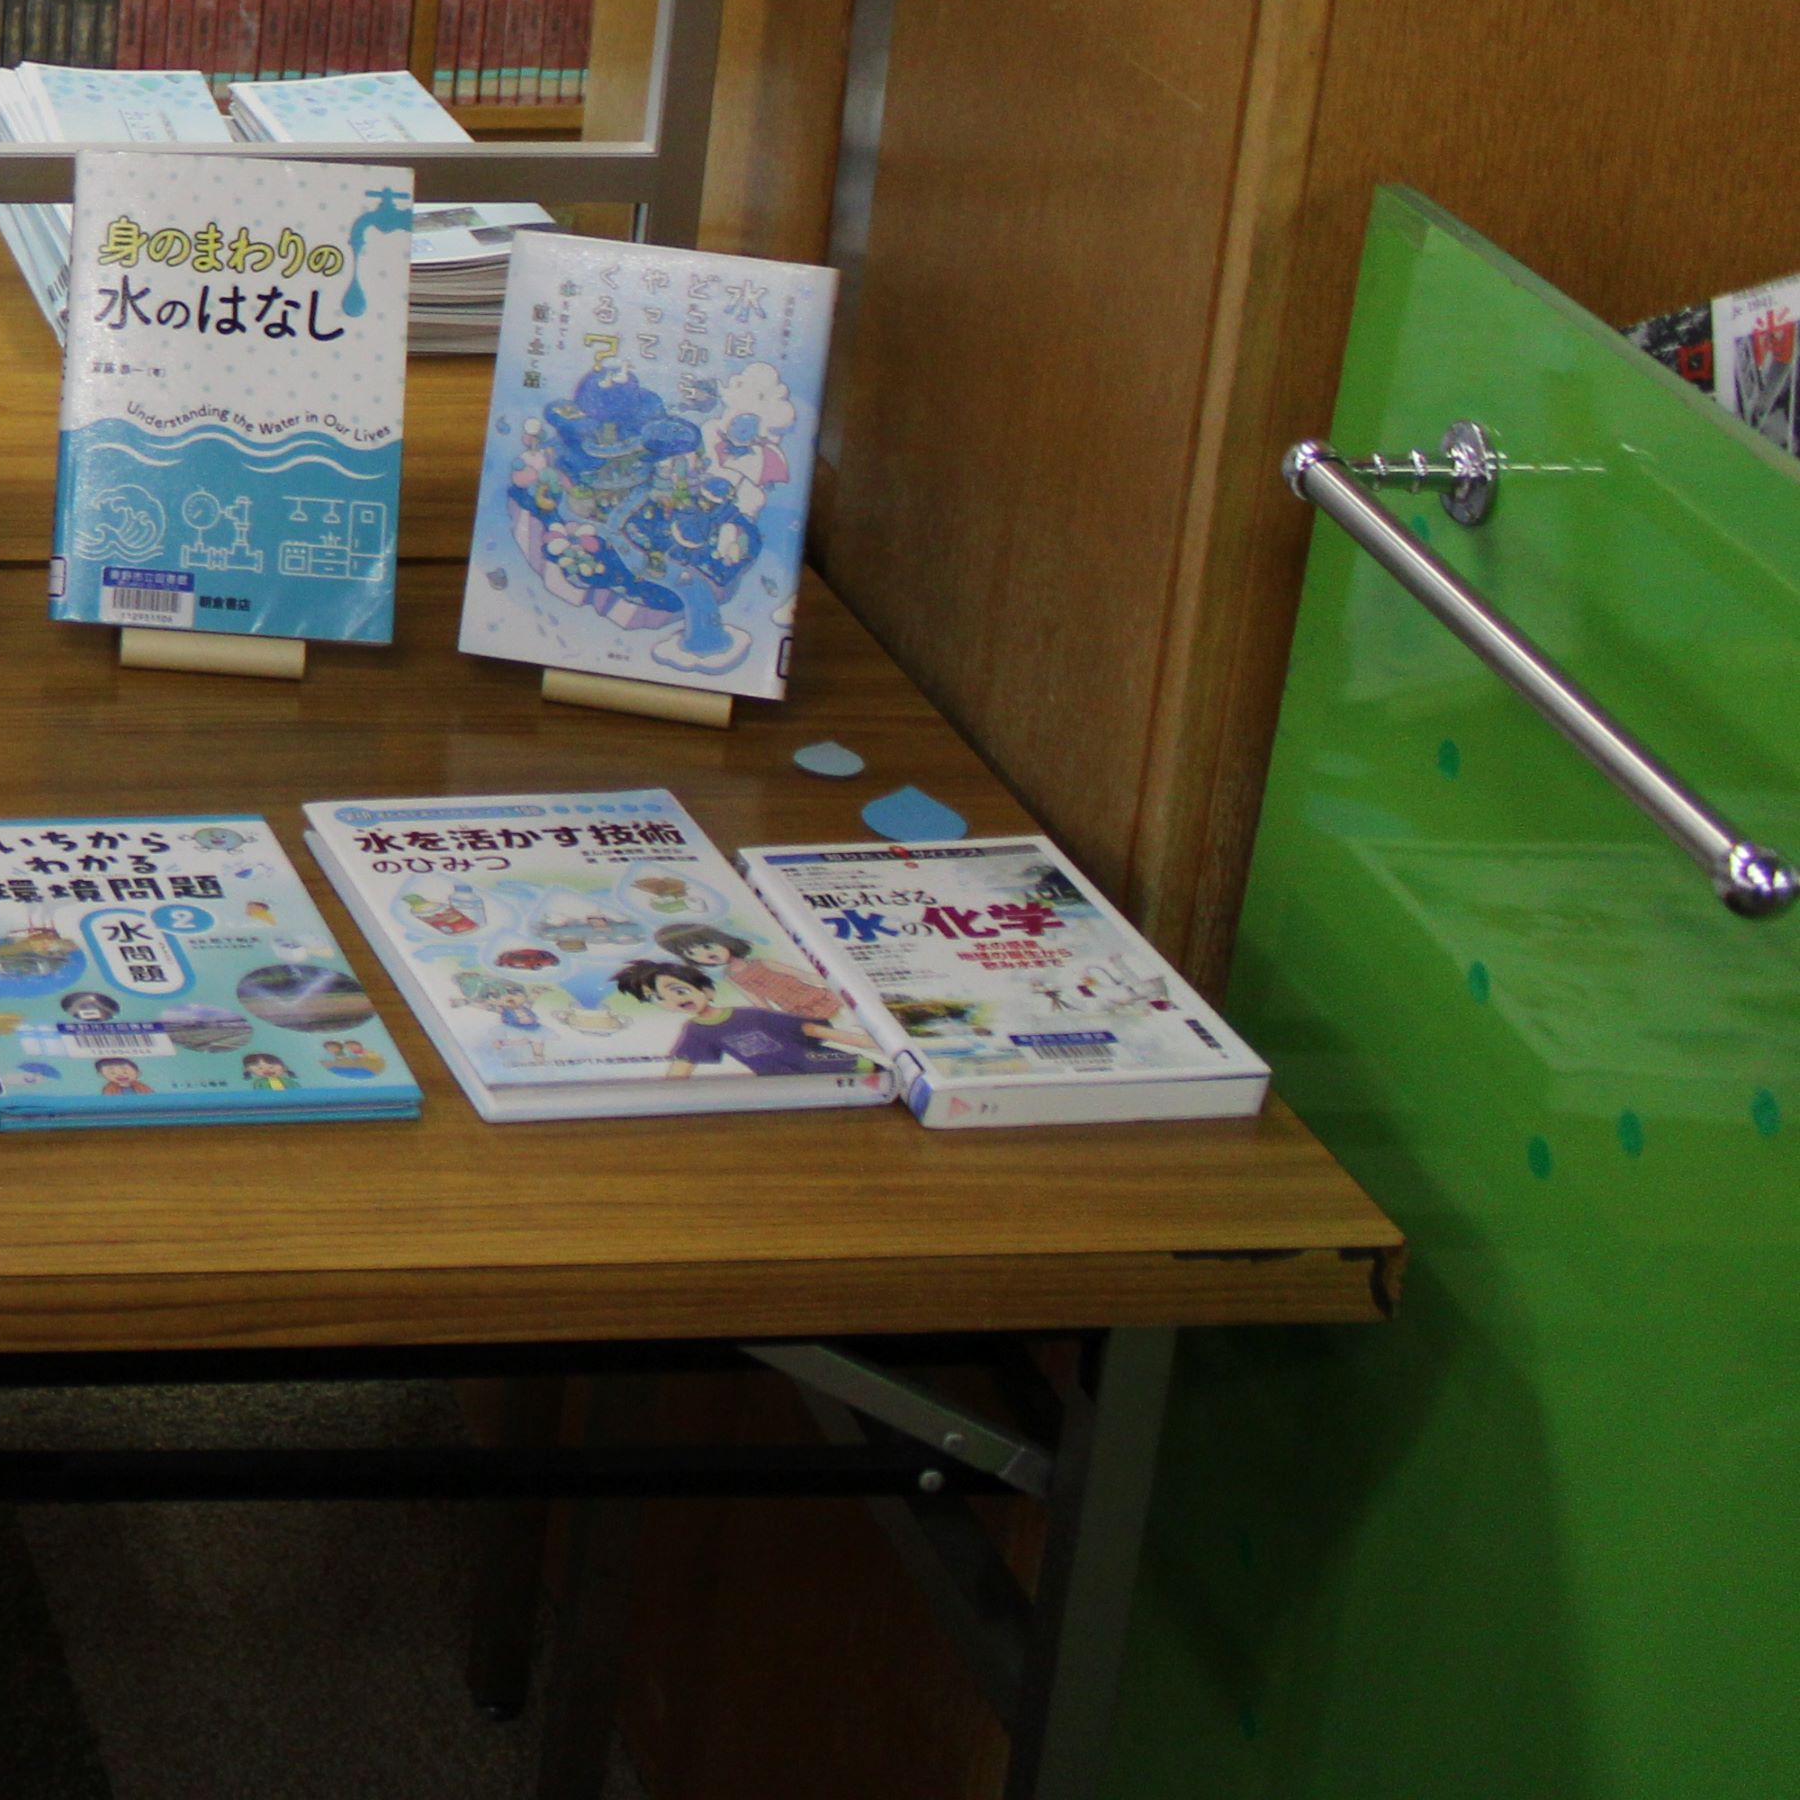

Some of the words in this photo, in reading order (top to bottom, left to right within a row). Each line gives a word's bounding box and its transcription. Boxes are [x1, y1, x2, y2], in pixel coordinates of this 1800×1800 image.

[99, 216, 345, 279] 身のまわりの
[94, 277, 346, 343] 水のはなし
[126, 400, 230, 430] Understanding
[233, 410, 255, 433] the
[258, 413, 302, 437] Water
[304, 410, 319, 424] in
[323, 413, 351, 437] Our
[353, 426, 392, 443] Lives
[353, 820, 687, 854] 水を活かす技術
[24, 853, 160, 875] わかる
[372, 855, 511, 874] のひみつ
[802, 889, 937, 910] 知られざる
[169, 908, 197, 929] 2
[821, 901, 1066, 942] 水の化学
[102, 920, 168, 983] 水問題
